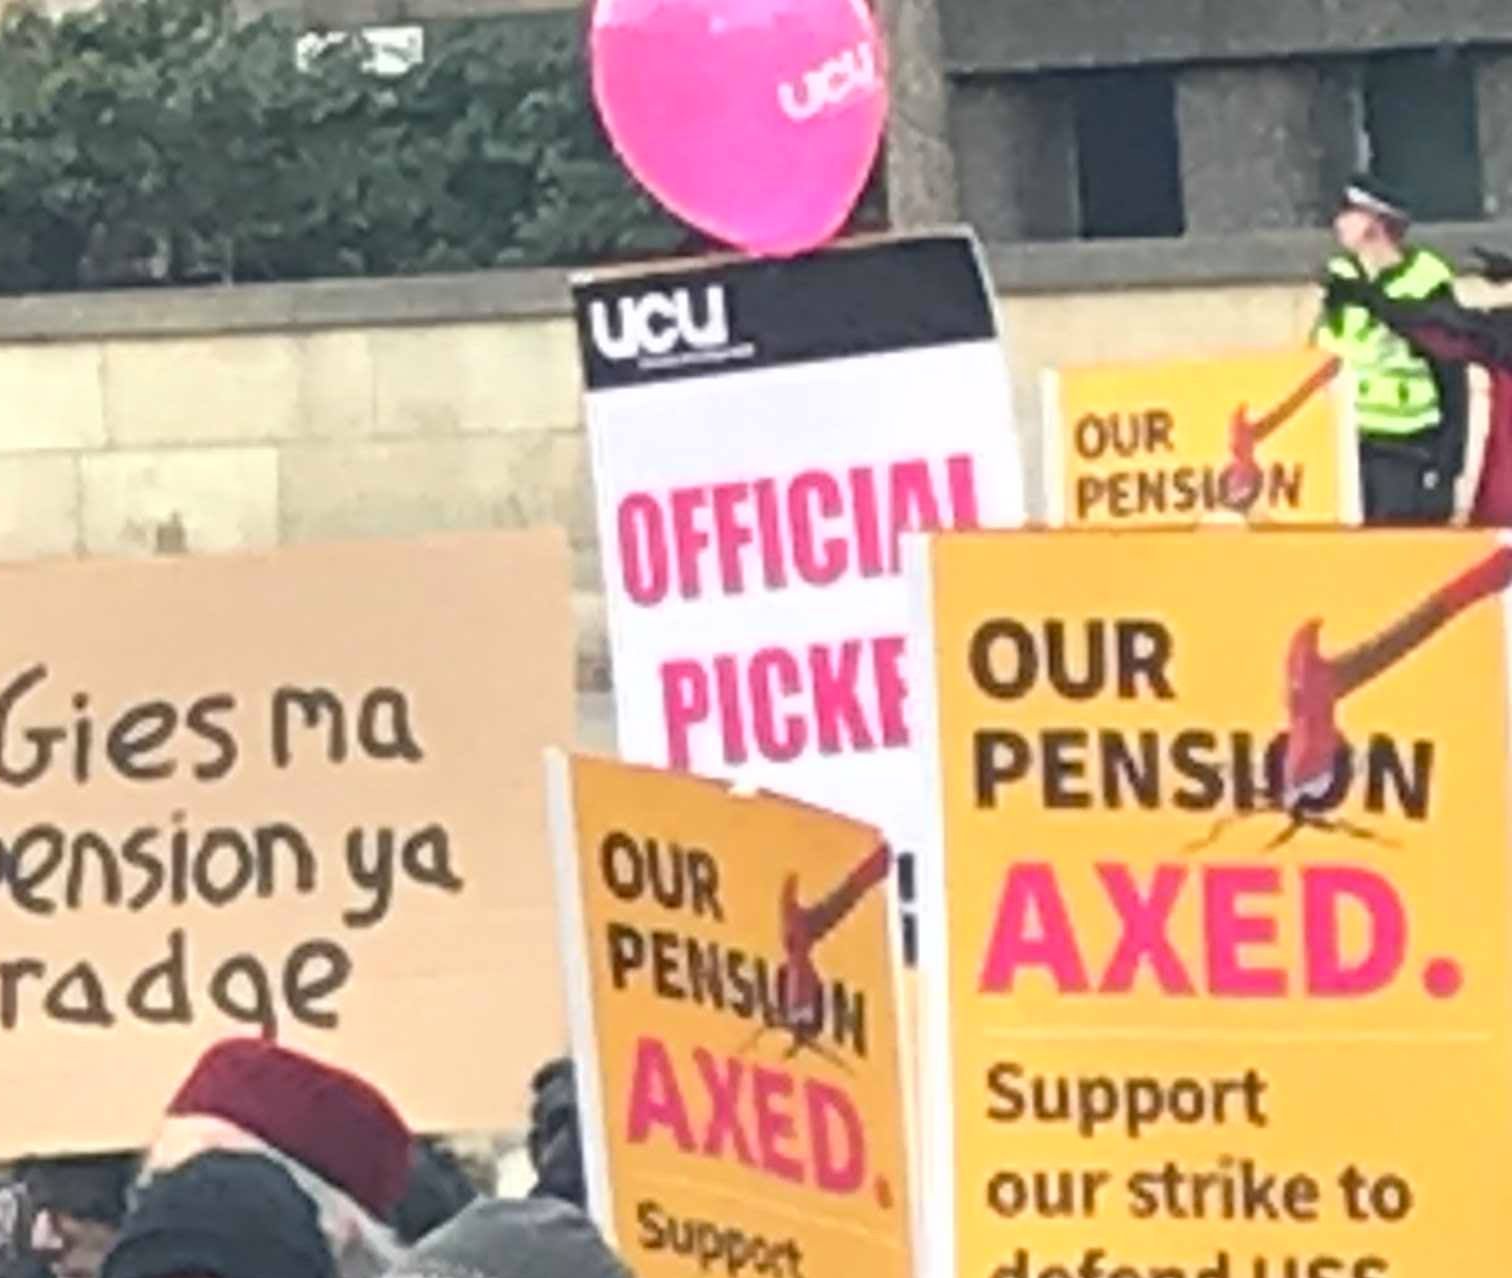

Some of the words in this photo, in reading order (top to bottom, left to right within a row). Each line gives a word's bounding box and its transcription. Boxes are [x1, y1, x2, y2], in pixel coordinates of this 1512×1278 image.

[1075, 409, 1175, 459] OUR
[1076, 462, 1305, 519] PENSION
[659, 636, 912, 771] PICKE
[967, 618, 1176, 701] OUR
[272, 686, 424, 769] ma
[973, 728, 1435, 821] PENSION
[342, 824, 464, 928] ya
[601, 831, 724, 923] OUR
[977, 860, 1464, 1000] AXED.
[607, 922, 867, 1060] PENSION
[626, 1035, 894, 1210] AXED.
[987, 1062, 1268, 1138] Support
[987, 1168, 1110, 1218] our
[1128, 1155, 1320, 1221] strike
[1340, 1165, 1415, 1221] to
